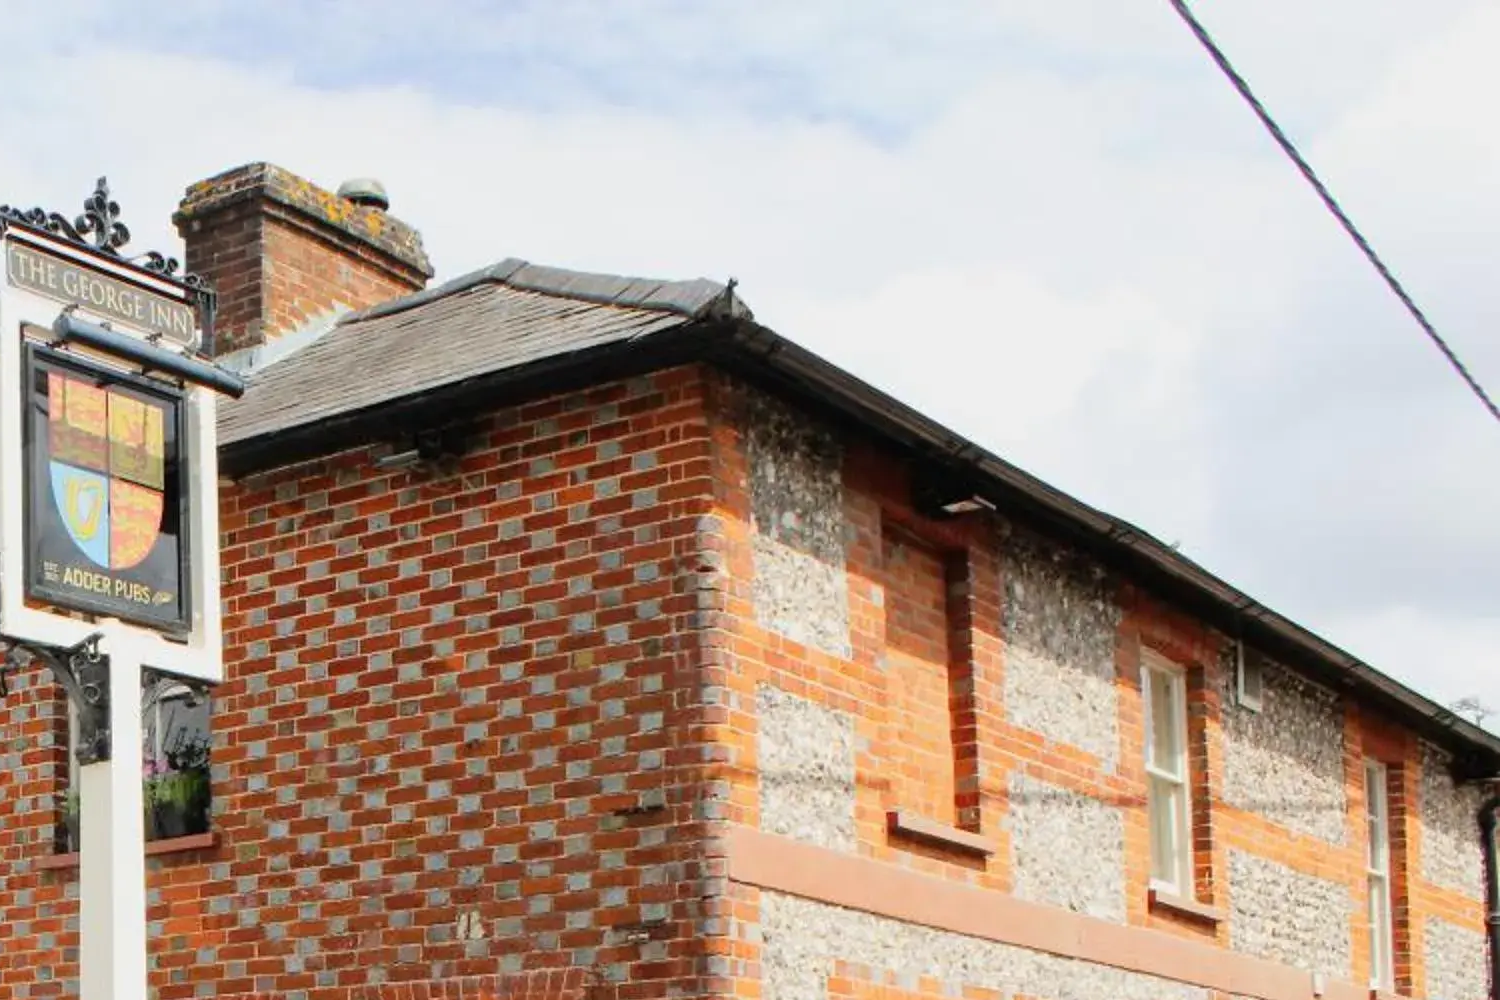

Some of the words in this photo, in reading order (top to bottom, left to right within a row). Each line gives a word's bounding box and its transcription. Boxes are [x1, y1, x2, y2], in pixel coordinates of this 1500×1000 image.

[15, 252, 57, 289] THE
[63, 270, 145, 320] GEORGE
[150, 301, 188, 335] INN
[63, 567, 111, 597] ADDER
[115, 579, 150, 605] PUBS
